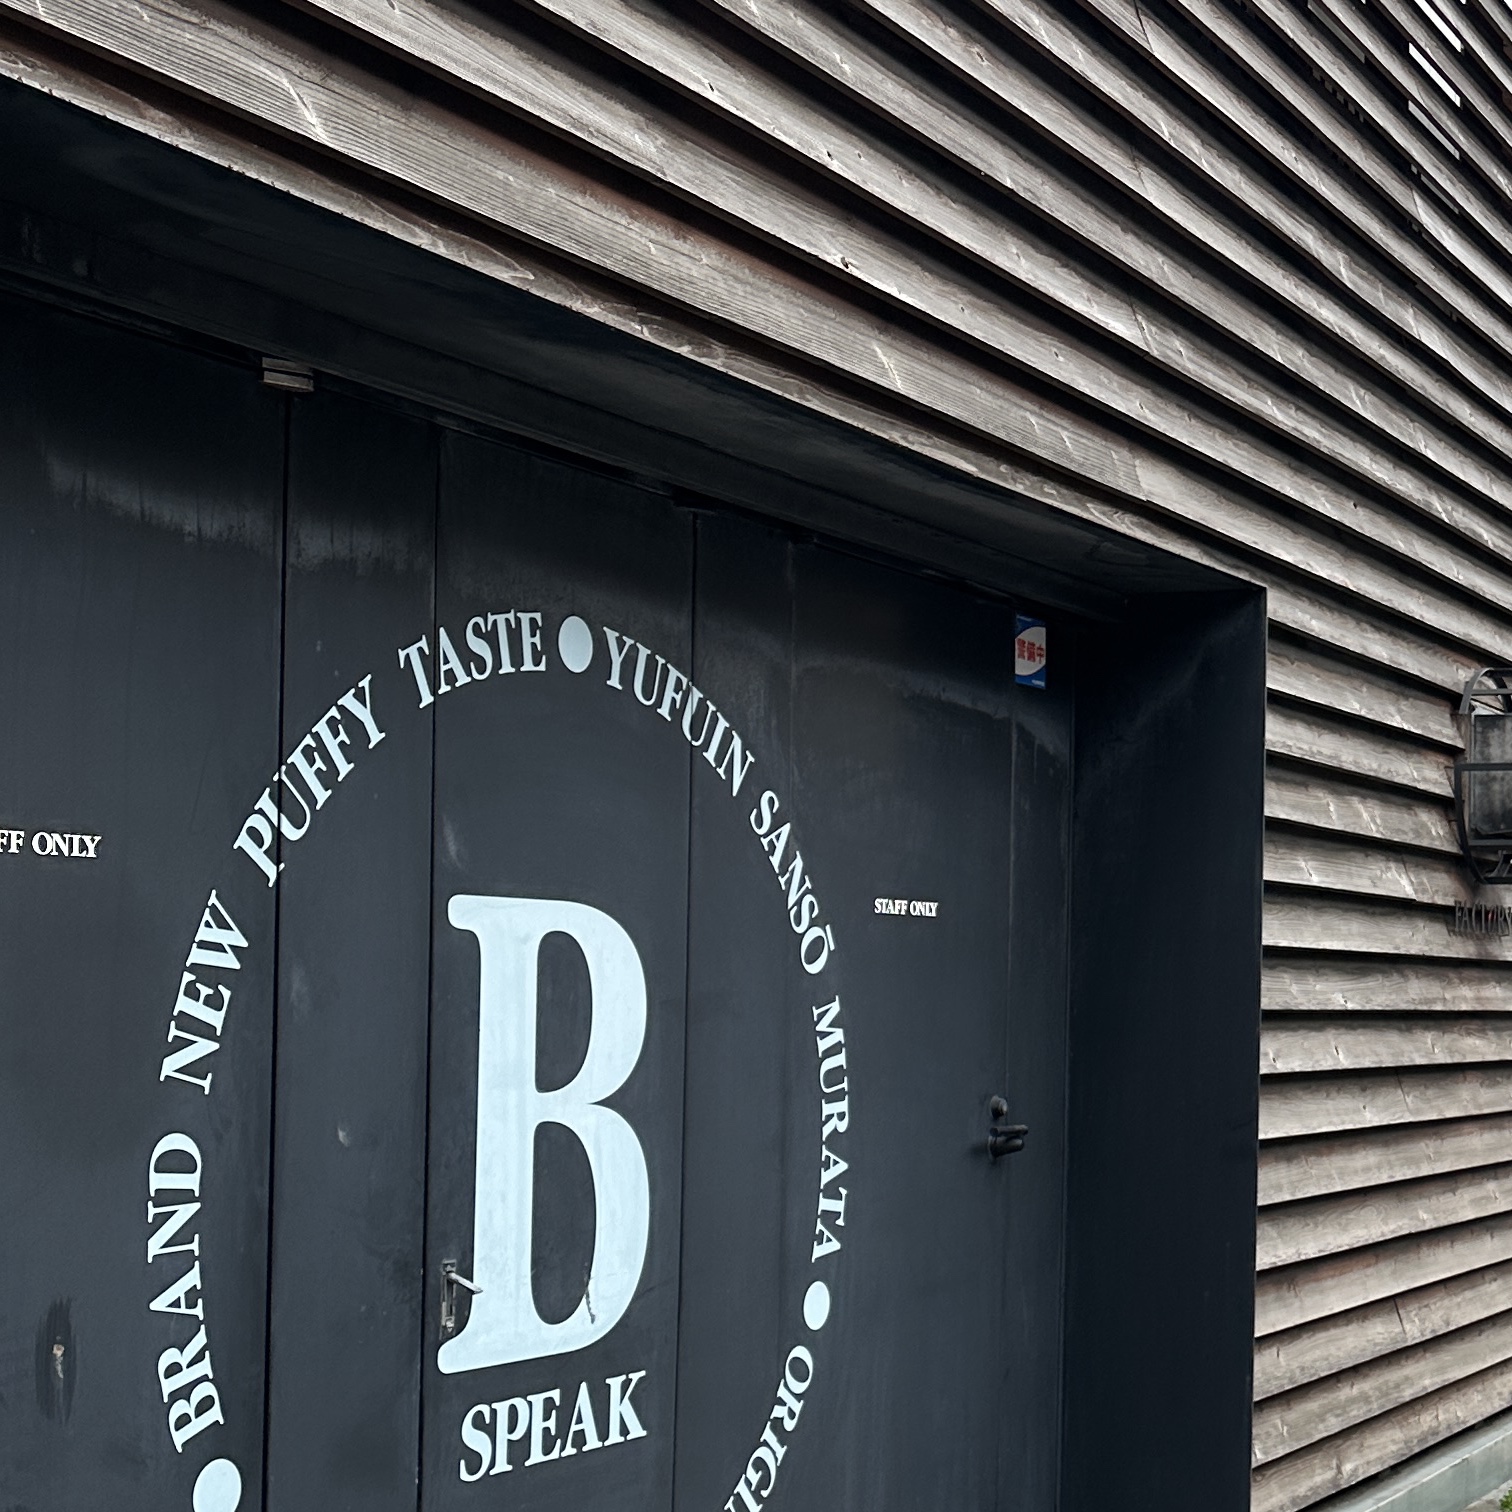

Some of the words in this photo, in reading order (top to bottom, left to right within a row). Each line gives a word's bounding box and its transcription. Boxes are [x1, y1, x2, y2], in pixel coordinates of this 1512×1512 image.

[398, 609, 546, 709] TASTE
[31, 831, 102, 858] ONLY
[233, 674, 386, 888] PUFFY
[603, 627, 755, 797] YUFUIN
[812, 995, 850, 1264] MURATA
[874, 897, 908, 916] STAFF
[909, 900, 939, 918] ONLY
[1454, 902, 1512, 935] FACTORY
[160, 890, 249, 1095] NEW
[438, 895, 650, 1375] B
[148, 1133, 225, 1454] BRAND
[460, 1370, 648, 1482] SPEAK
